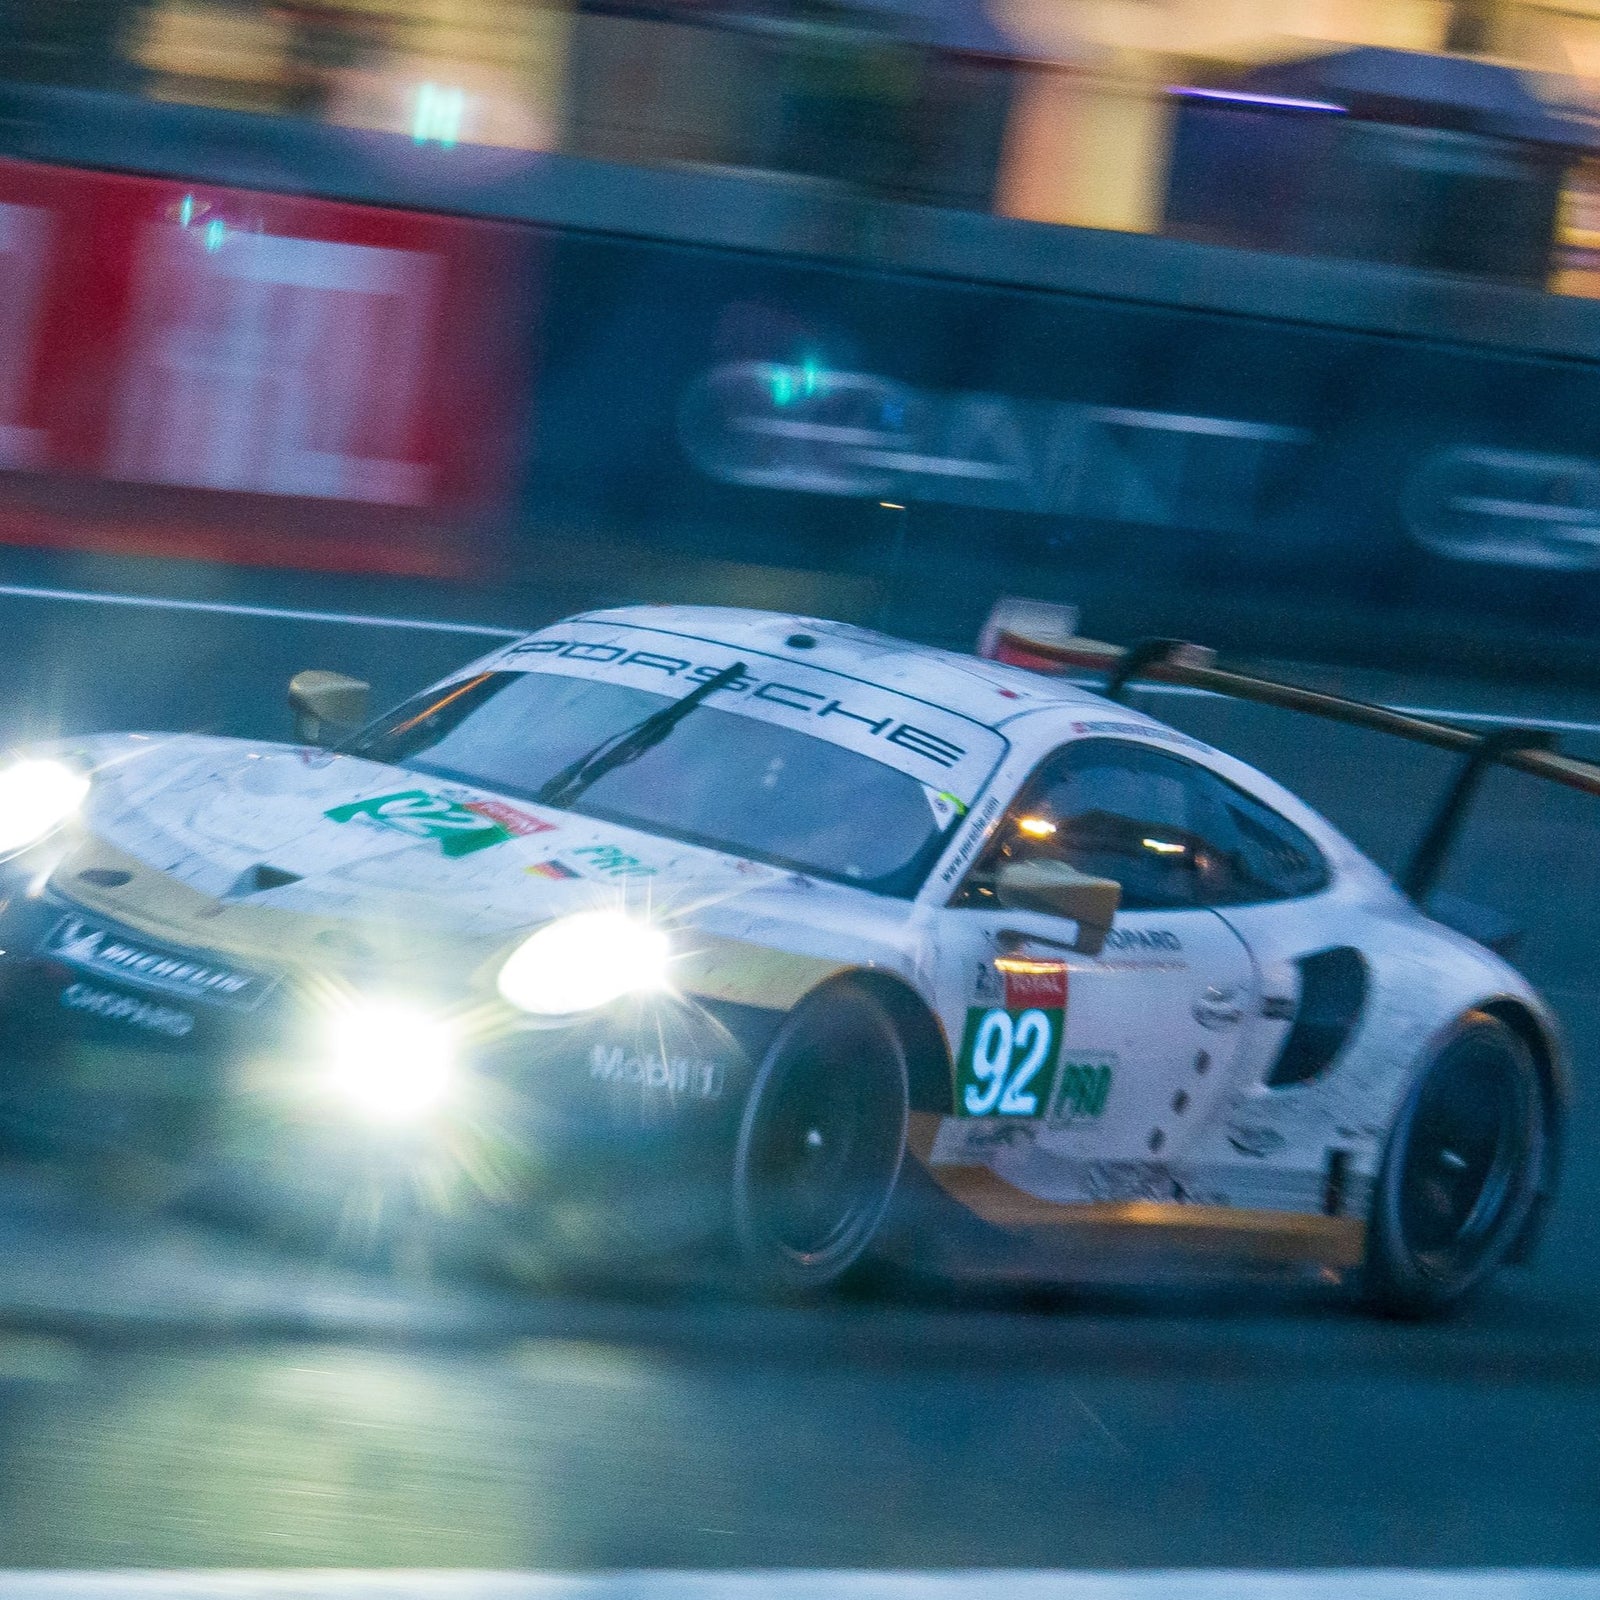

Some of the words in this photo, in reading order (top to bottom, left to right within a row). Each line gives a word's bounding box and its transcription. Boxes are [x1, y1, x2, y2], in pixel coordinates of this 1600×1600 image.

[509, 638, 967, 768] PORSCHE
[100, 943, 250, 993] MICHELIN
[590, 1044, 688, 1092] Mobil
[965, 1008, 1049, 1116] 92
